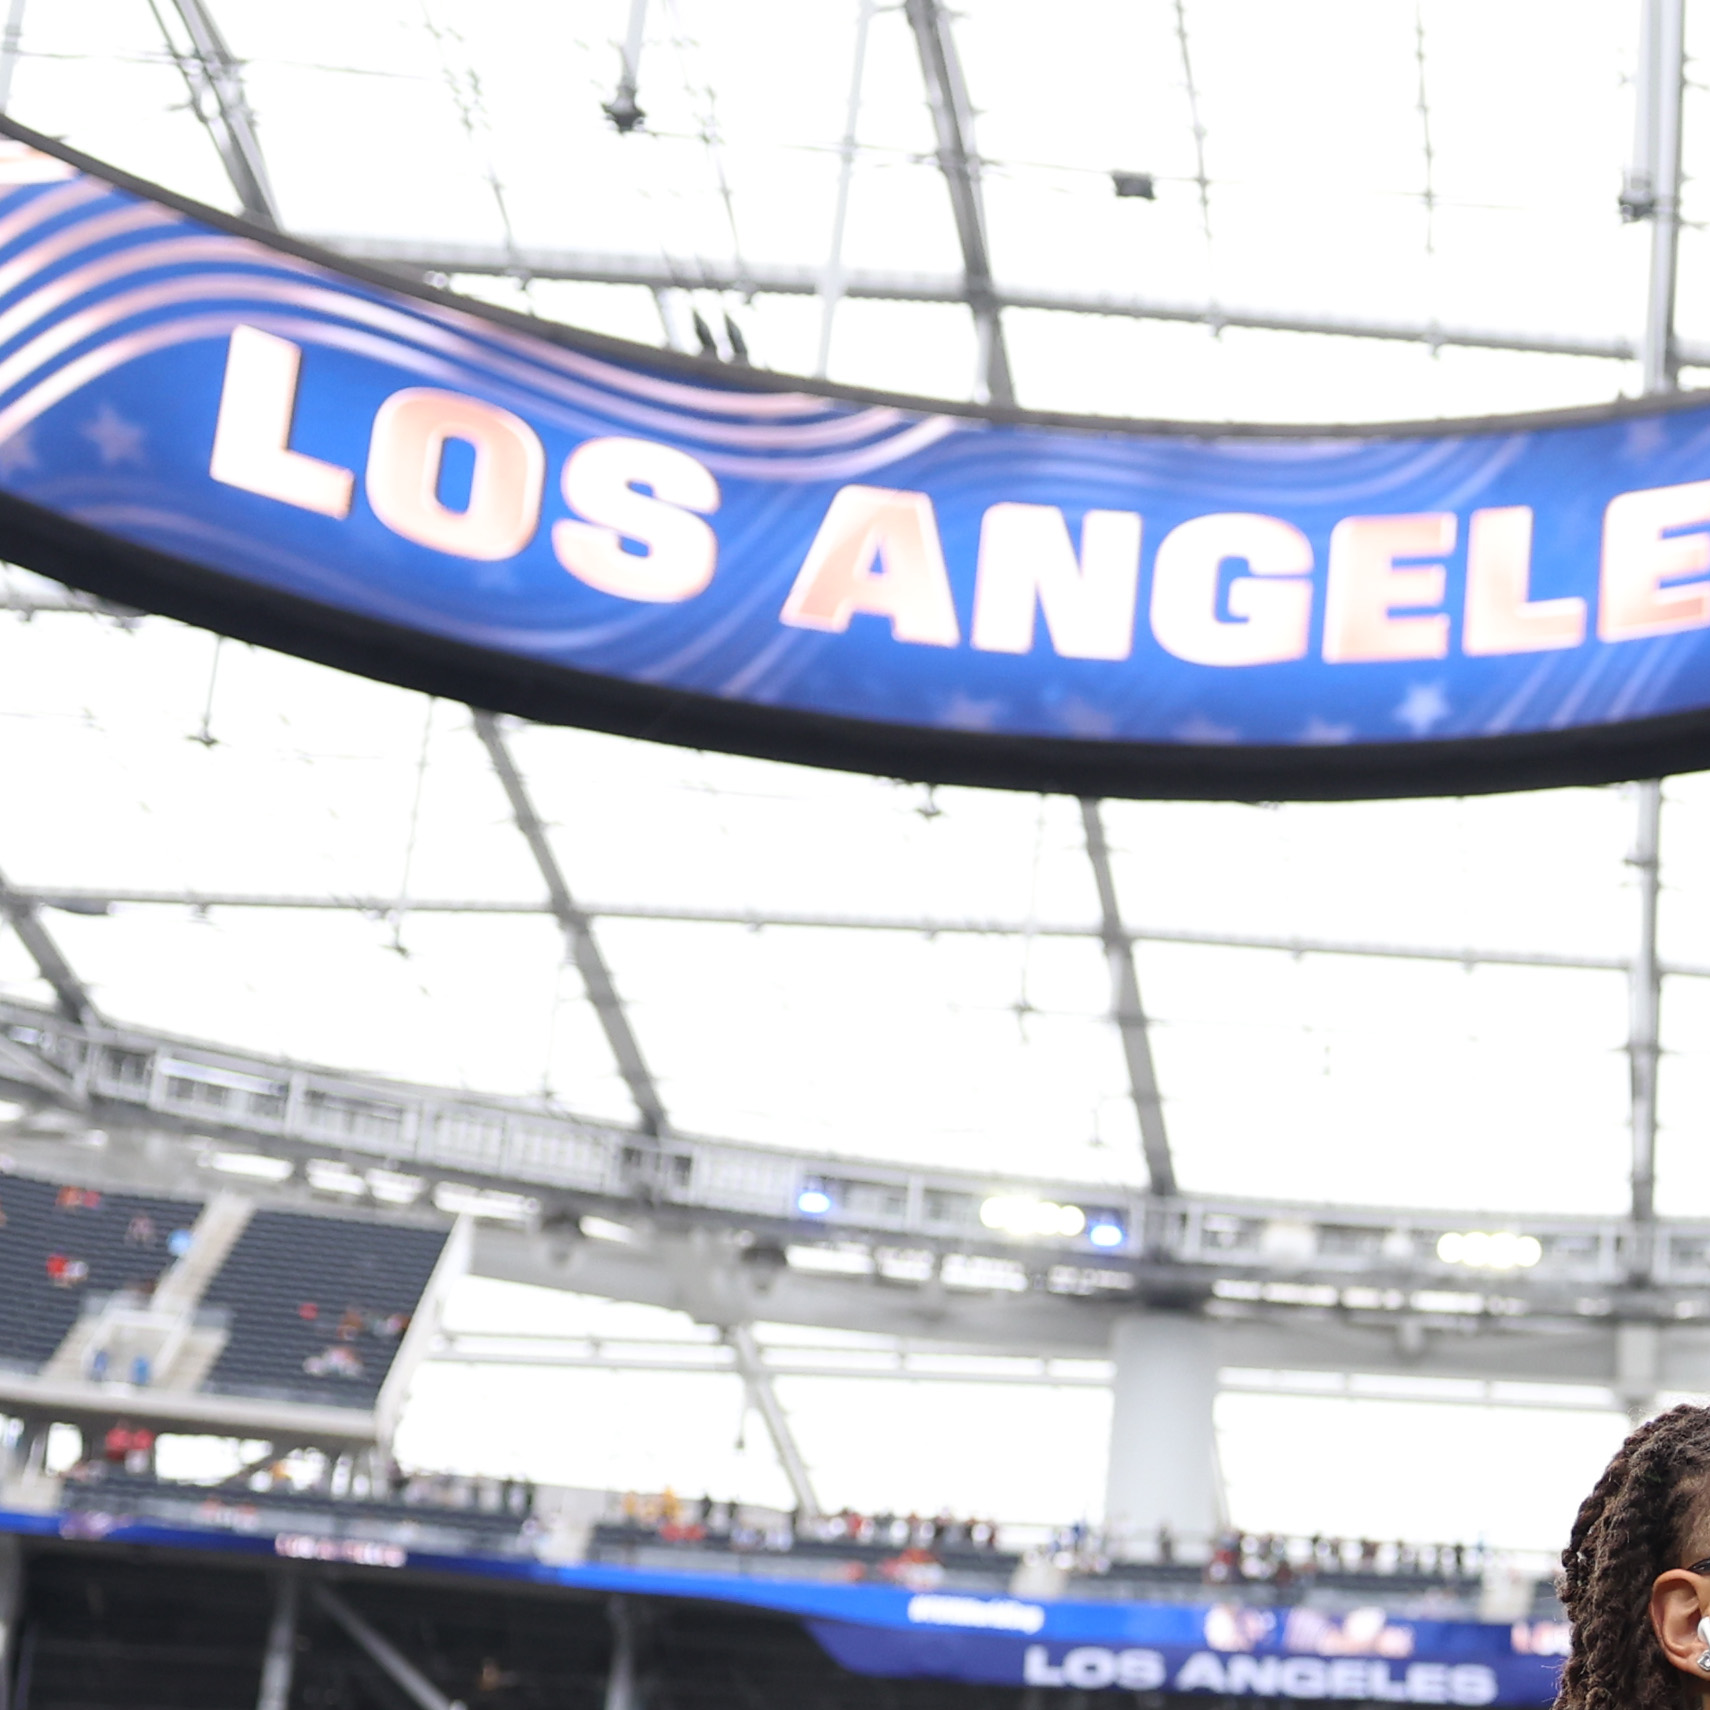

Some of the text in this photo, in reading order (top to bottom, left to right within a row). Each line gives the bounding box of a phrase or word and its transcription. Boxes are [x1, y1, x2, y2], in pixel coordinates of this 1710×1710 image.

[209, 323, 721, 604] LOS
[1022, 1643, 1500, 1708] LOS ANGELES
